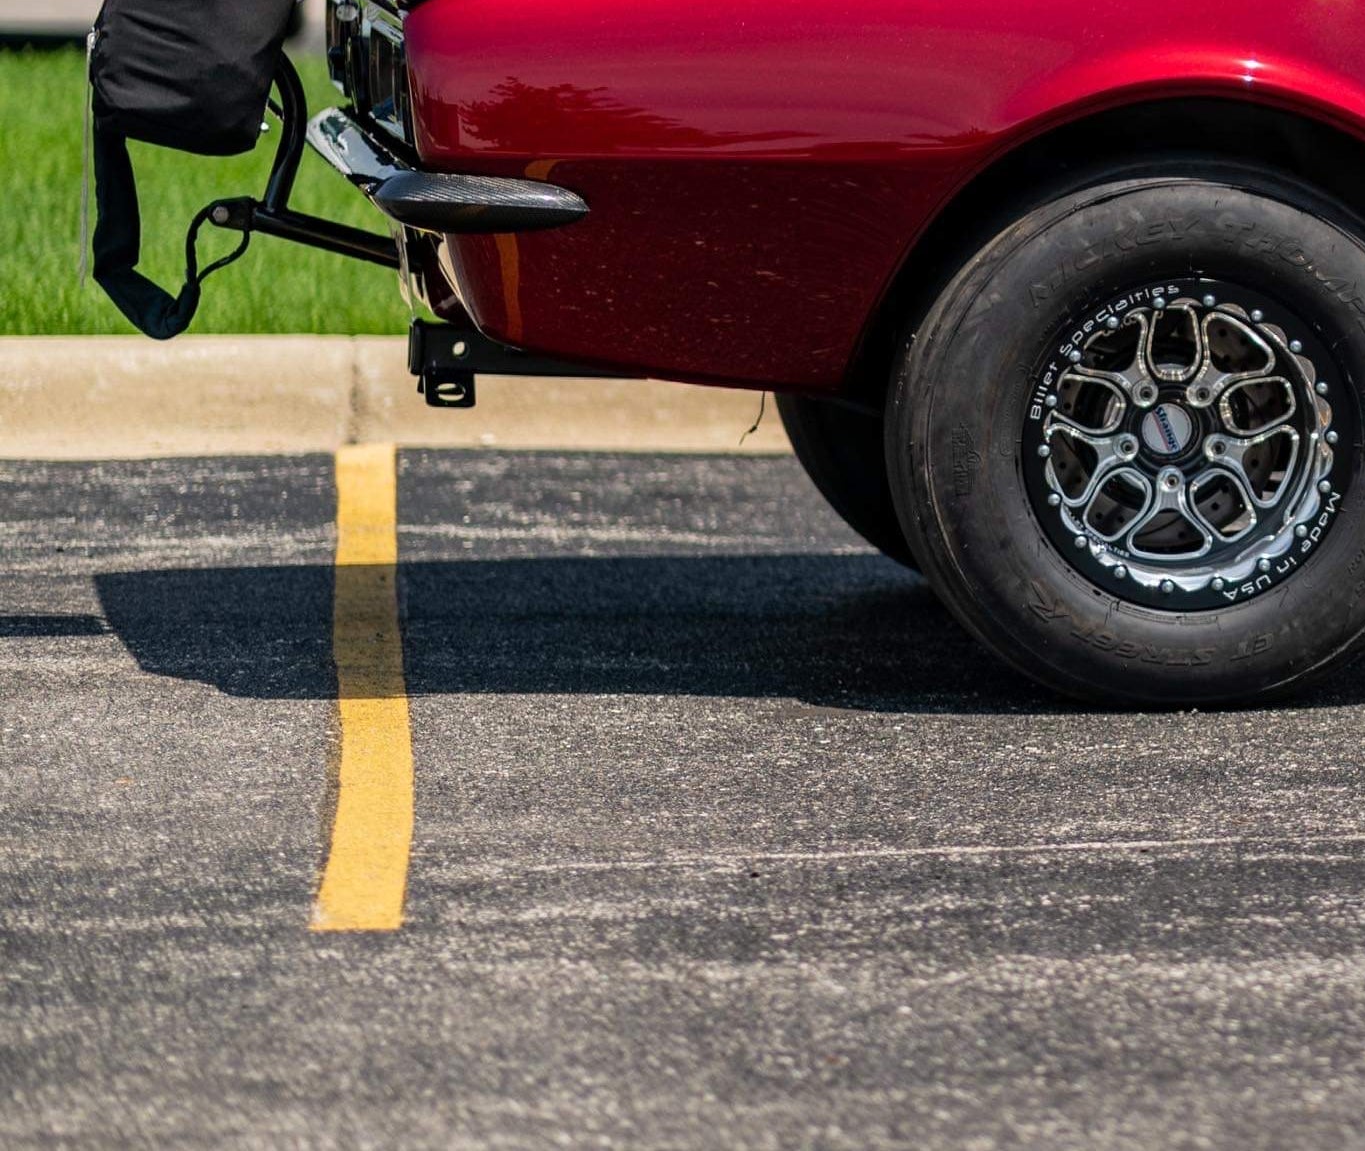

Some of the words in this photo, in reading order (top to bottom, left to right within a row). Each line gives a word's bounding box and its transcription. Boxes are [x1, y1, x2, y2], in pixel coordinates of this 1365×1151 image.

[1030, 361, 1058, 420] Billet
[1059, 284, 1180, 357] Specialties
[1301, 491, 1341, 553] Made
[1276, 556, 1297, 573] in
[1222, 574, 1272, 601] USA
